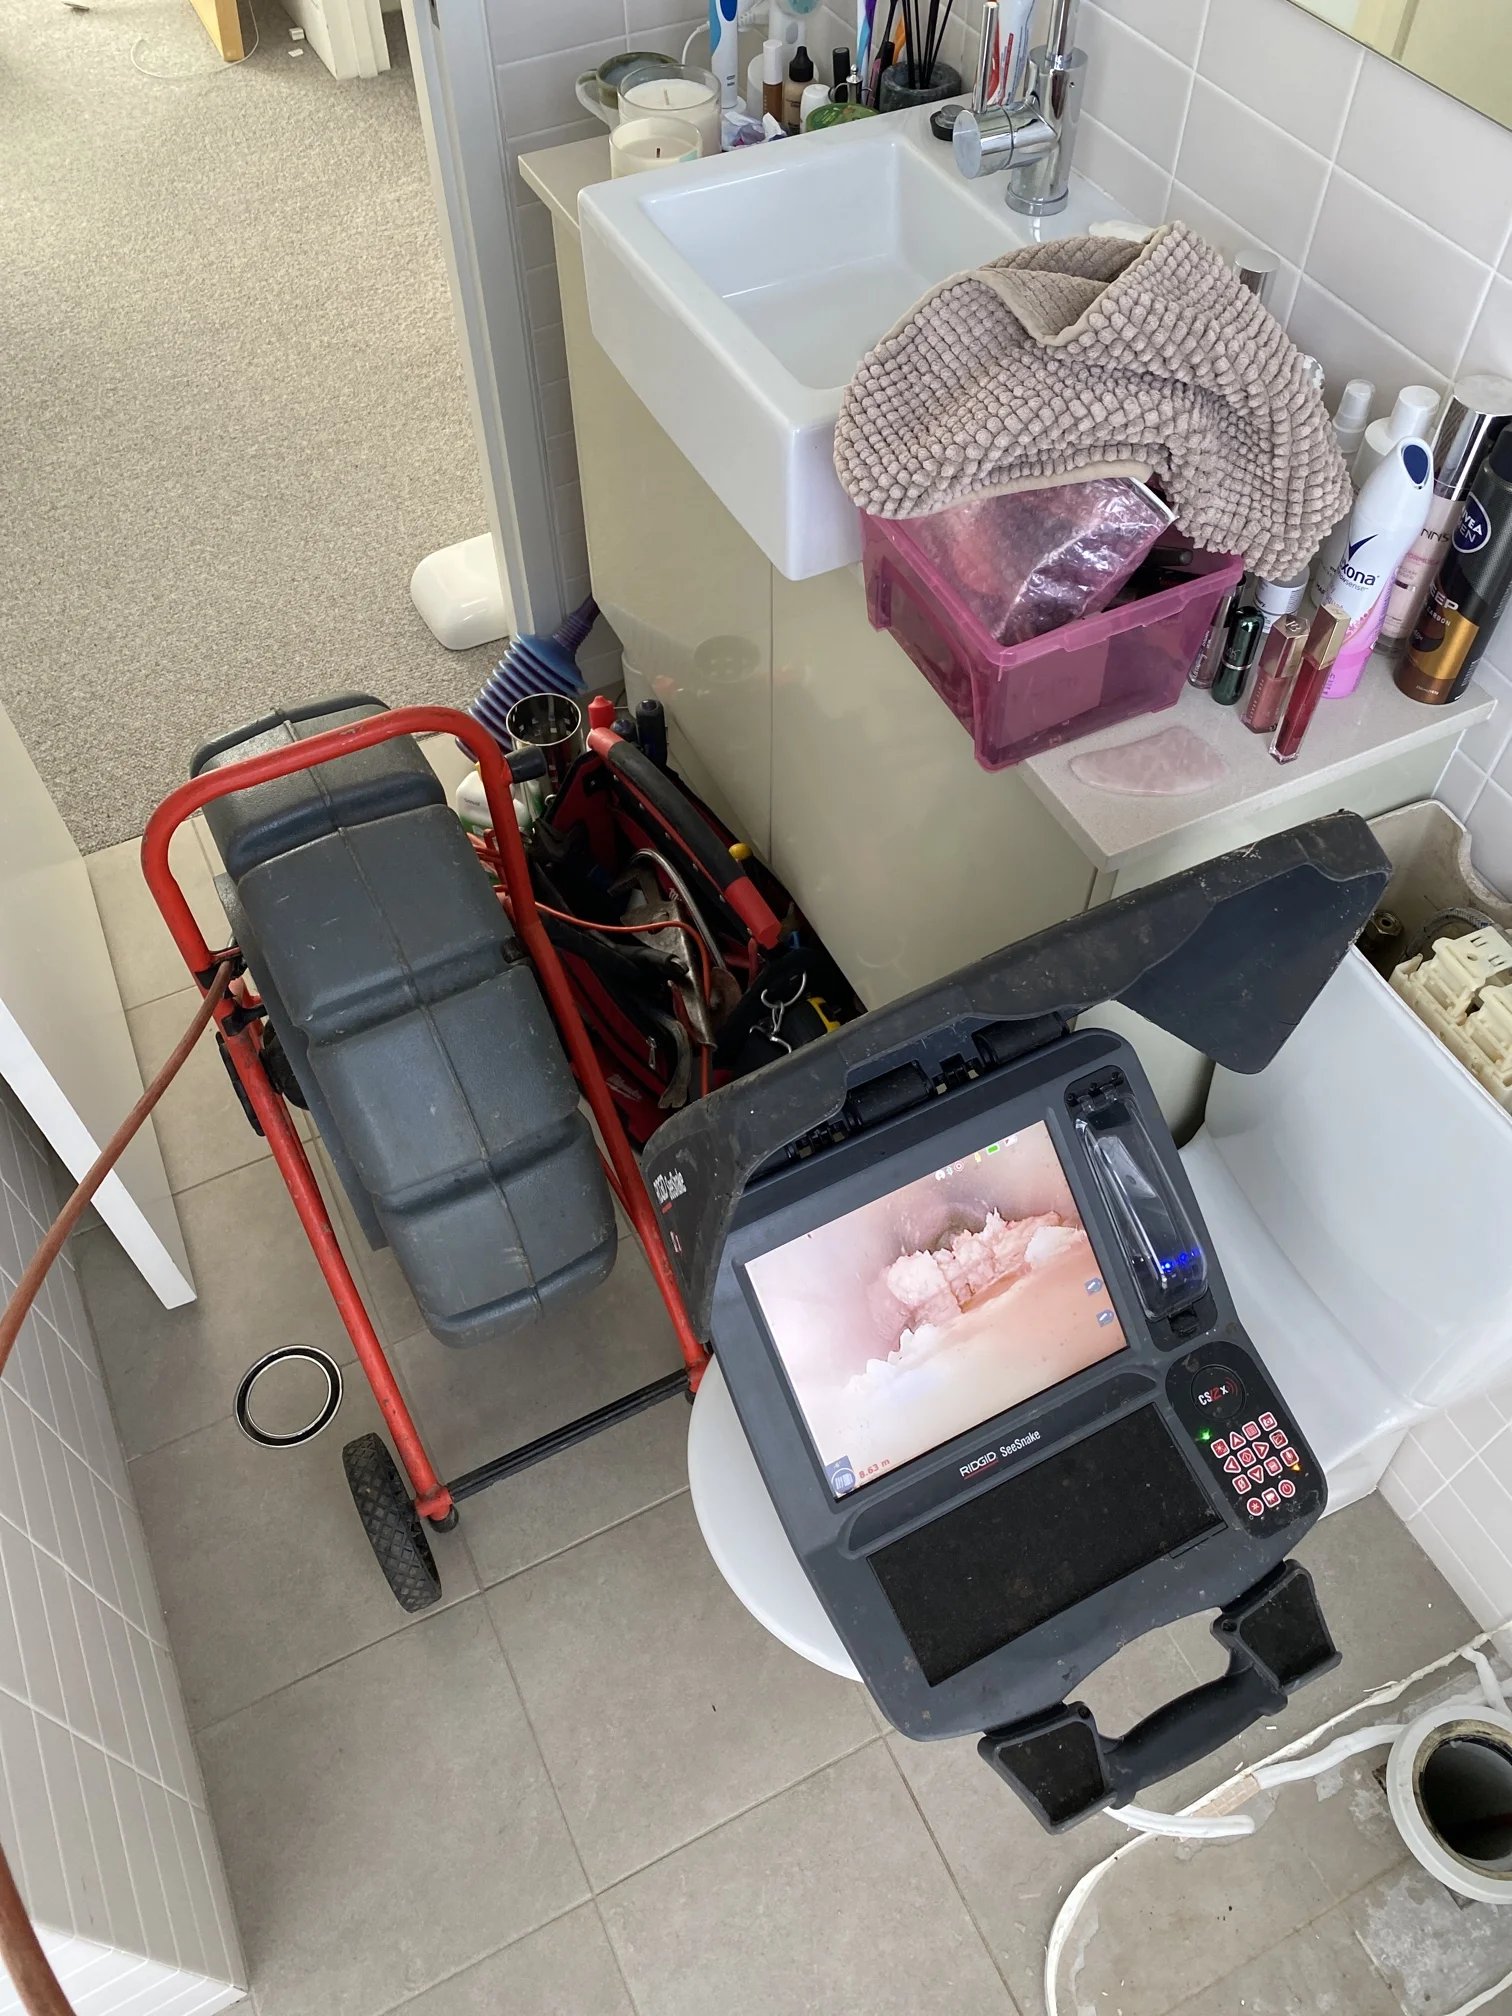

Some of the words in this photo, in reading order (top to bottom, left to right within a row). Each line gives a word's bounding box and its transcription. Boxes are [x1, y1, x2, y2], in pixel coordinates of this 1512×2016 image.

[1459, 524, 1476, 543] EN
[1340, 559, 1376, 586] xona
[1429, 580, 1459, 611] EEP
[959, 1451, 998, 1477] RIDGID
[999, 1430, 1041, 1458] SeeSnake
[858, 1463, 879, 1479] 8.63
[881, 1459, 890, 1467] m
